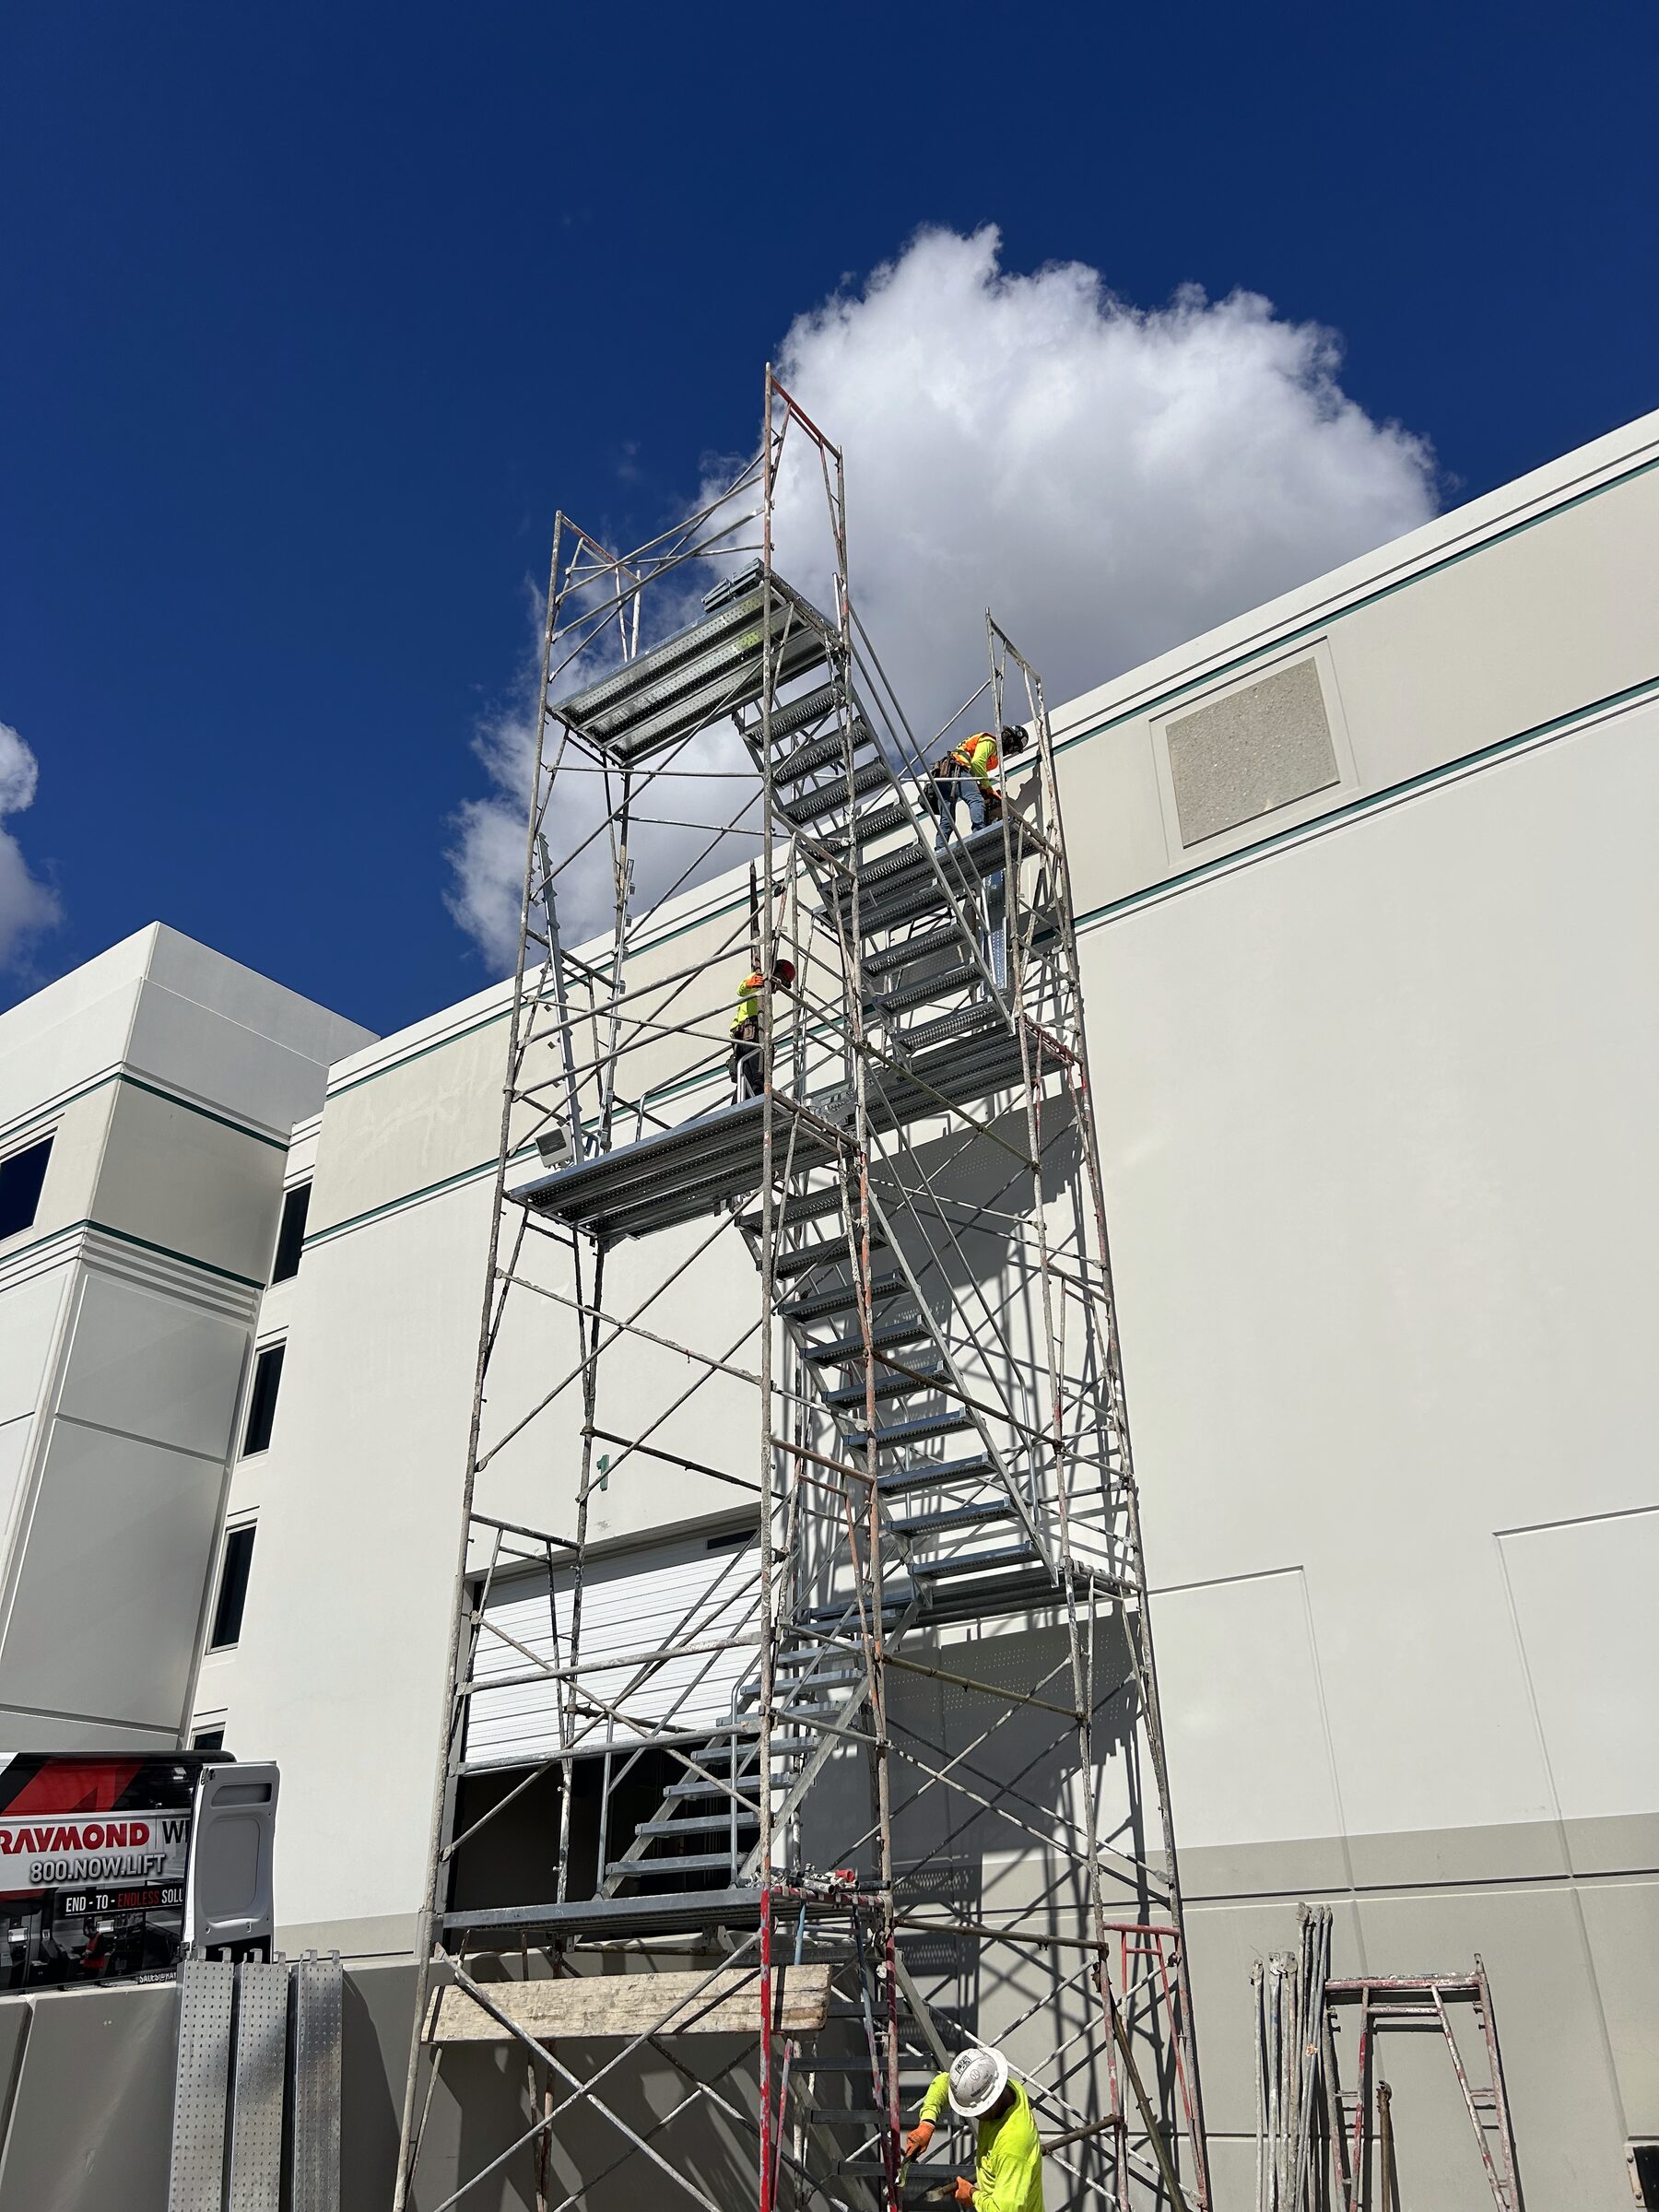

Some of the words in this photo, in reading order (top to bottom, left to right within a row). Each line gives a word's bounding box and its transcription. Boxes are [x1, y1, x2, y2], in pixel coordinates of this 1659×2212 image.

[596, 1454, 609, 1491] 1
[0, 1822, 150, 1854] RAYMOND
[30, 1854, 165, 1882] 800.NOW.LIFT
[65, 1897, 87, 1912] END
[96, 1895, 109, 1910] TO
[117, 1890, 159, 1908] ENDLESS
